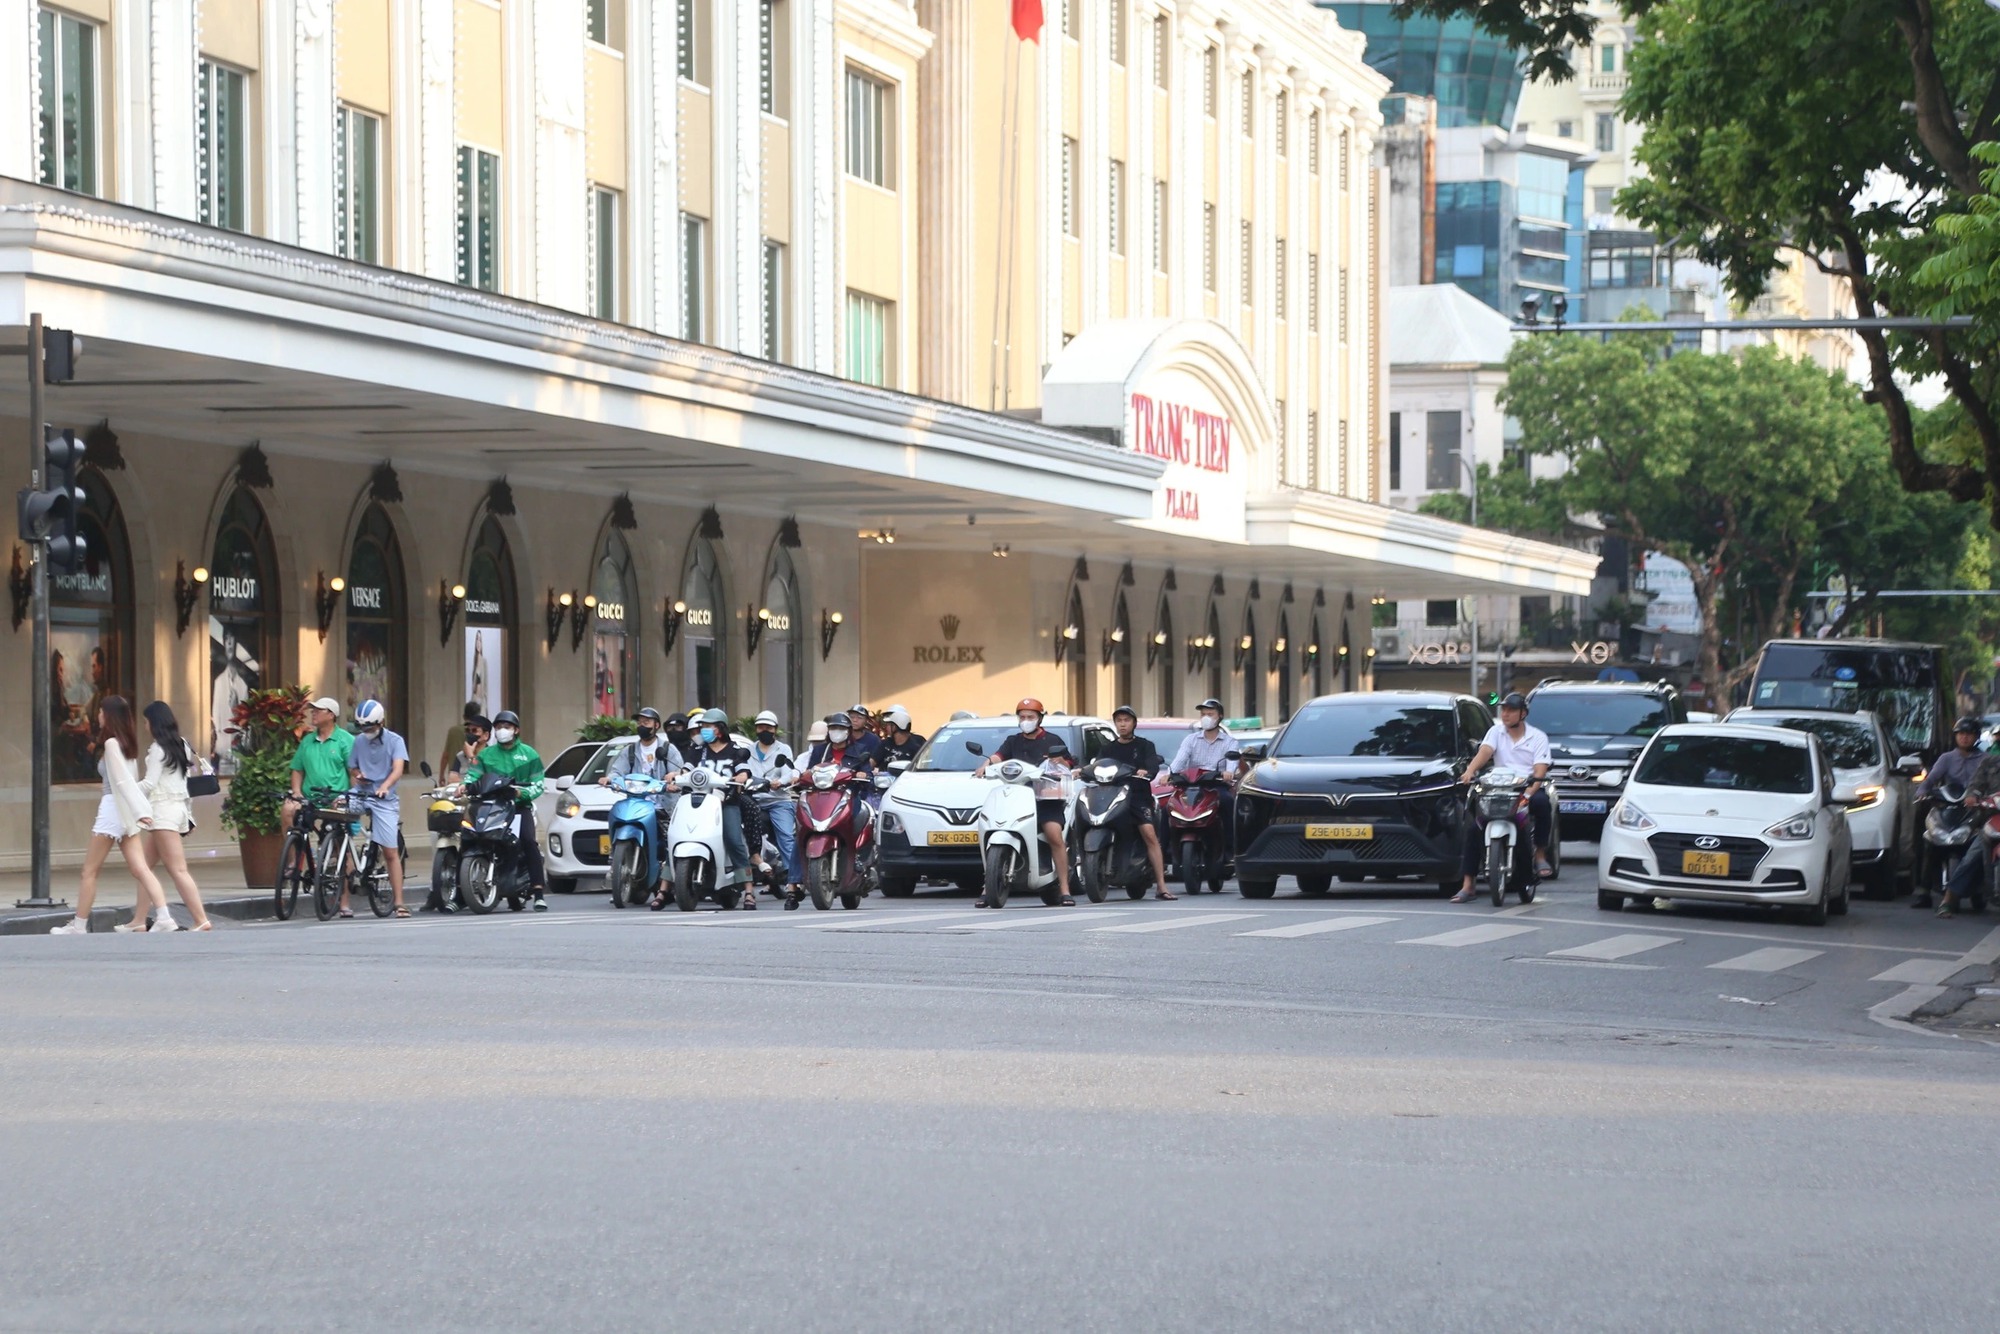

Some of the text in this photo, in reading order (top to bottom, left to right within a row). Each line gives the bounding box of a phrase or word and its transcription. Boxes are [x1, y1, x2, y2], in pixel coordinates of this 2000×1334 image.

[1131, 393, 1190, 465] TRANG
[1166, 487, 1199, 521] PLAZA
[56, 574, 107, 592] MONTBLANC
[213, 576, 256, 599] HUBLOT
[351, 586, 381, 609] VERSACE
[597, 602, 624, 620] GUCCI
[687, 608, 712, 626] GUCCI
[766, 614, 789, 631] GUCCI
[913, 645, 985, 663] ROLEX
[932, 833, 979, 843] 29K-026.0
[1311, 827, 1367, 837] 29E-015.34
